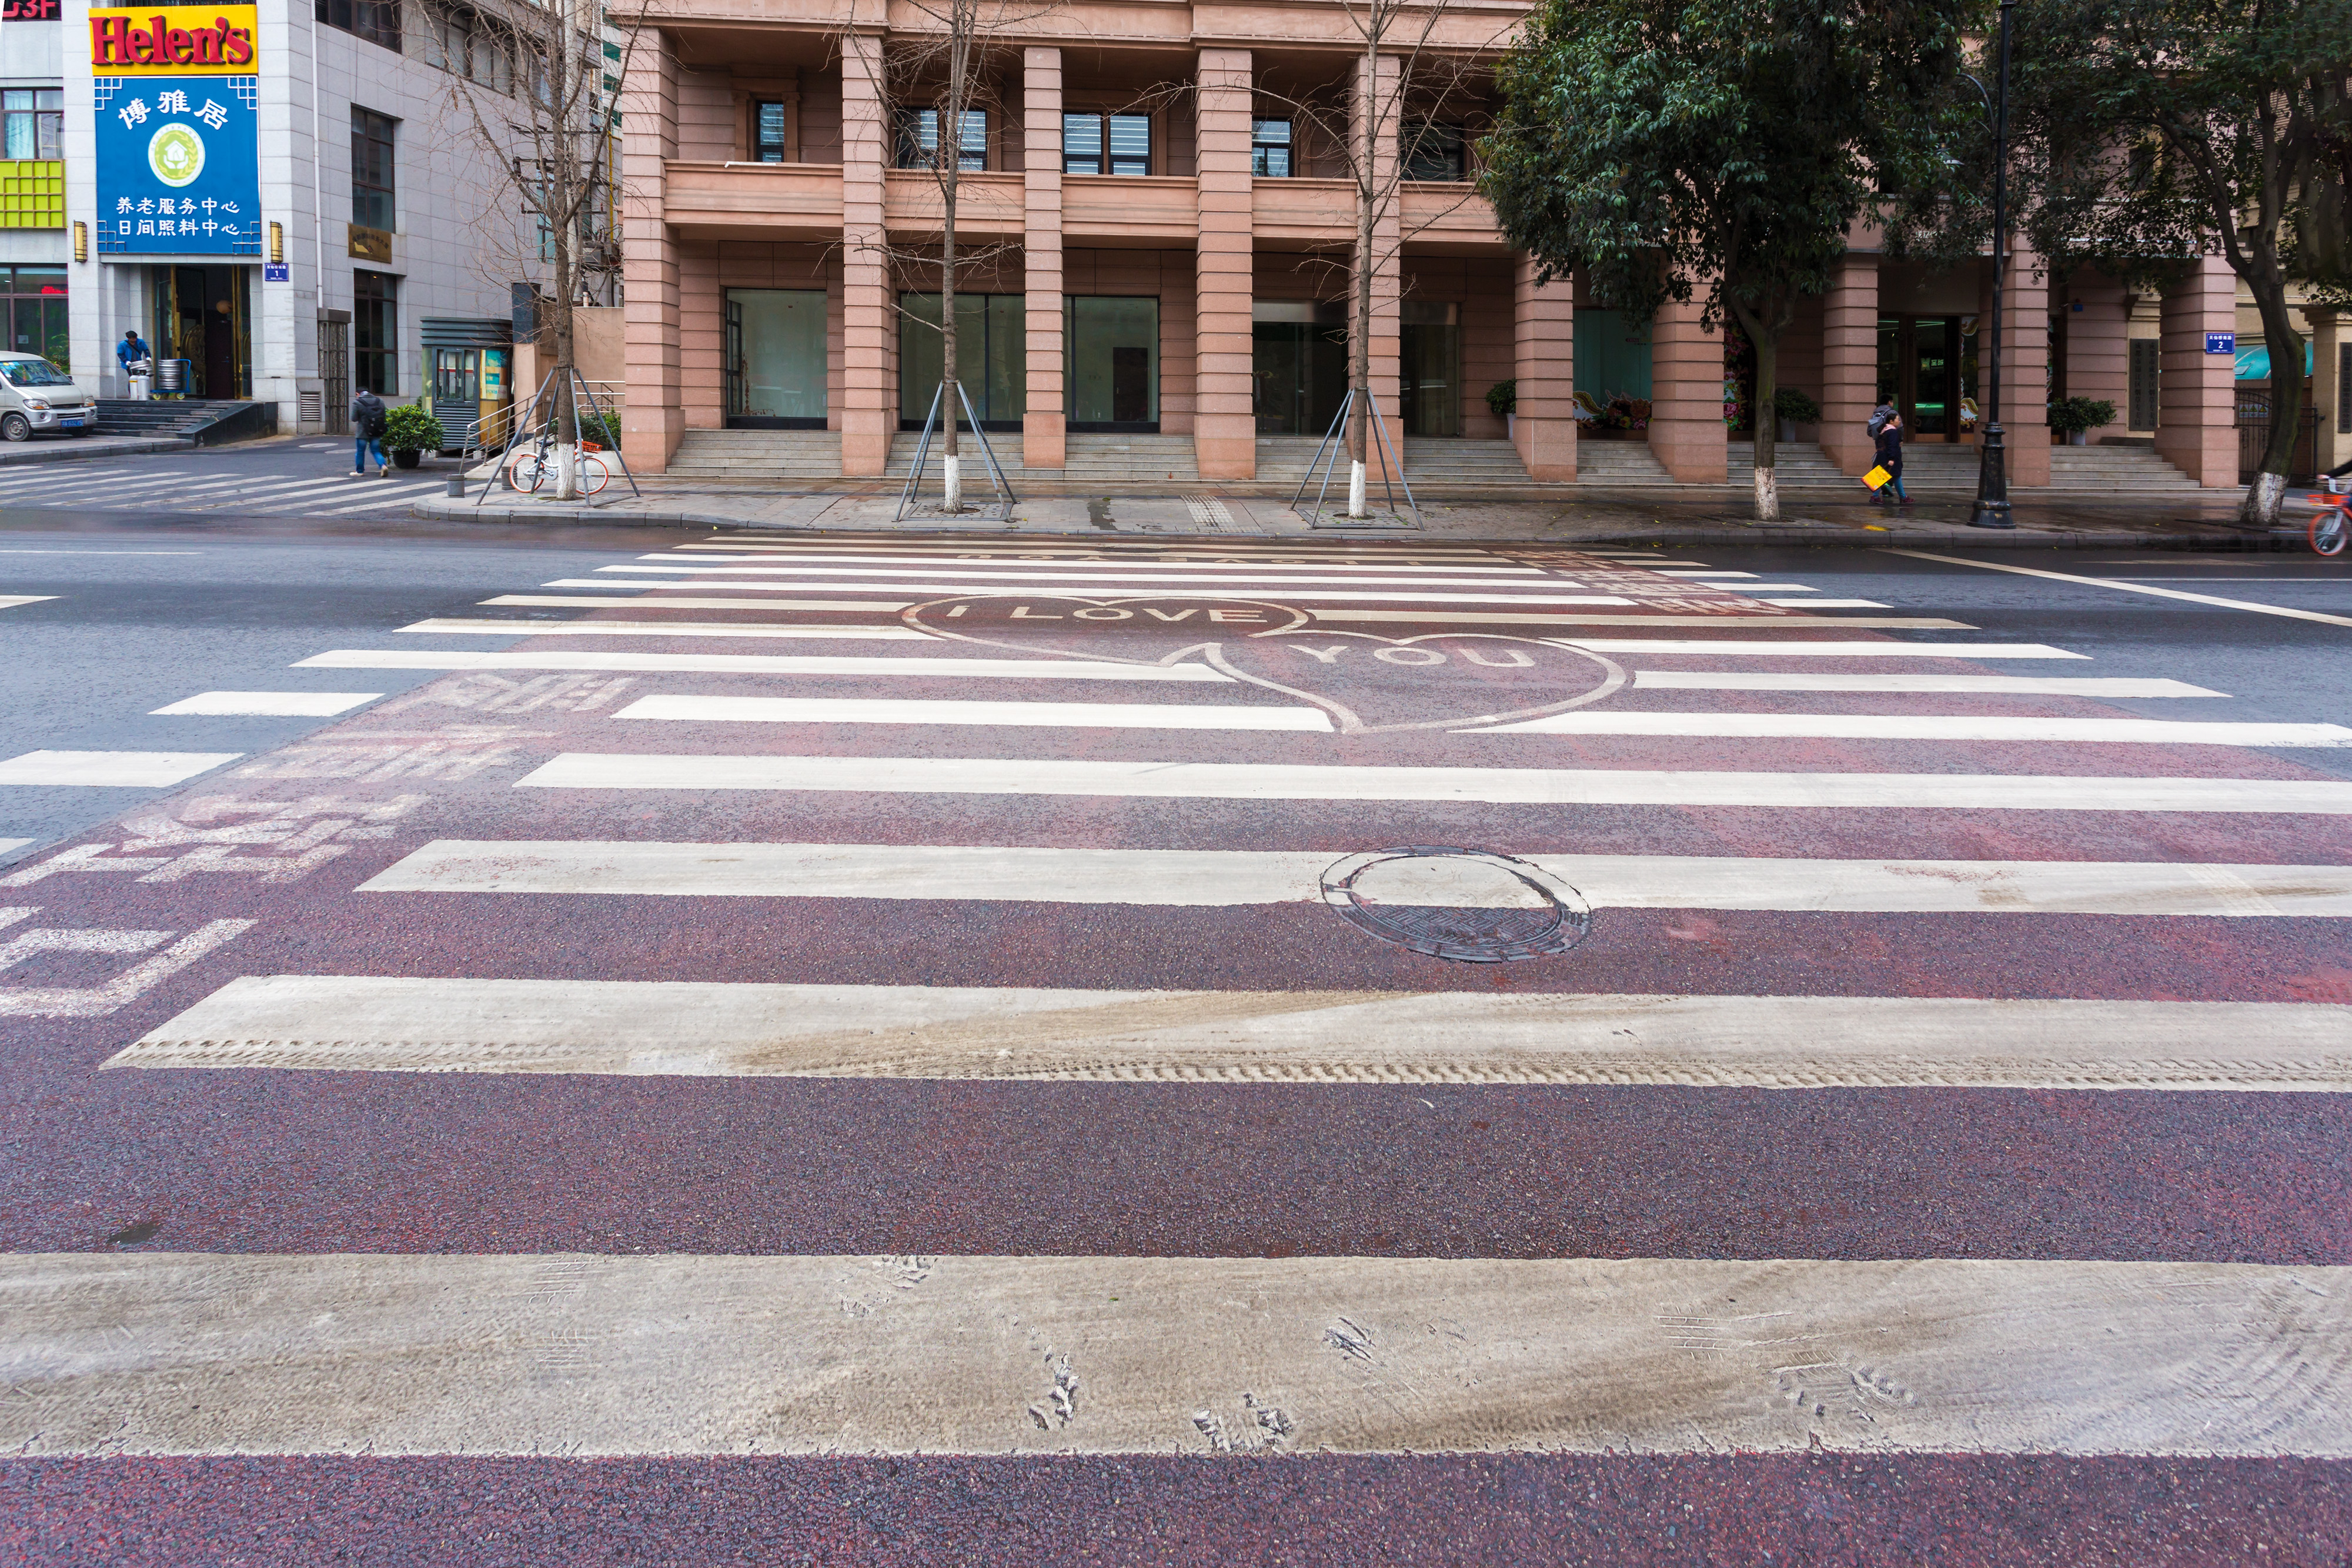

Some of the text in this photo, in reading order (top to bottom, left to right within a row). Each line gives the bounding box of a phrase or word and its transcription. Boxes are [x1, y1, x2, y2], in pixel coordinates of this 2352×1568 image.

[89, 15, 252, 66] Helen's
[118, 89, 228, 130] 博雅居
[116, 197, 240, 215] 养老服务中心
[119, 219, 240, 237] 日间照料中心
[1159, 557, 1359, 565] LOVE
[1491, 550, 1790, 615] 爱情斑马线
[946, 606, 1268, 623] I LOVE
[1288, 644, 1535, 667] YOU
